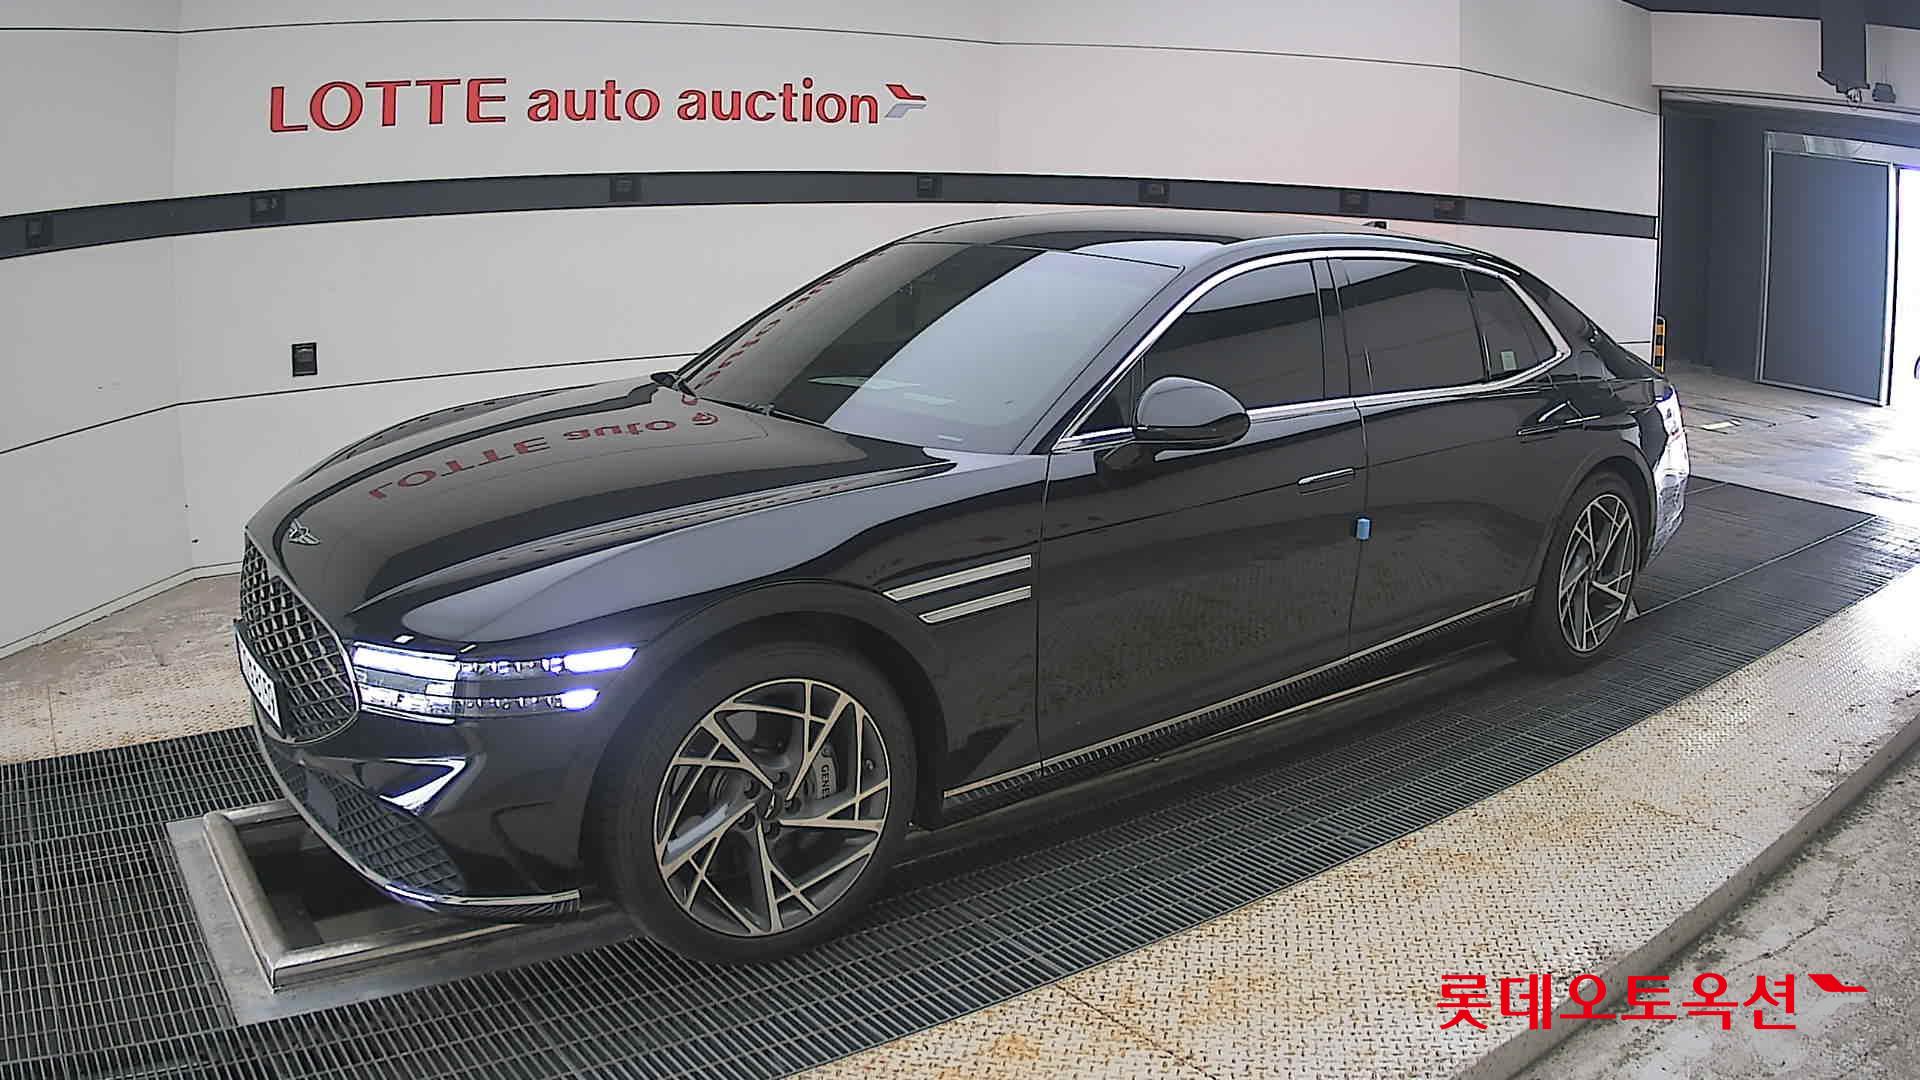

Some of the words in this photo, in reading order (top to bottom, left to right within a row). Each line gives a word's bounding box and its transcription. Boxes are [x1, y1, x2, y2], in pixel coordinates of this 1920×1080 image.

[269, 77, 507, 132] LOTTE
[526, 79, 661, 122] auto
[676, 77, 879, 124] auction
